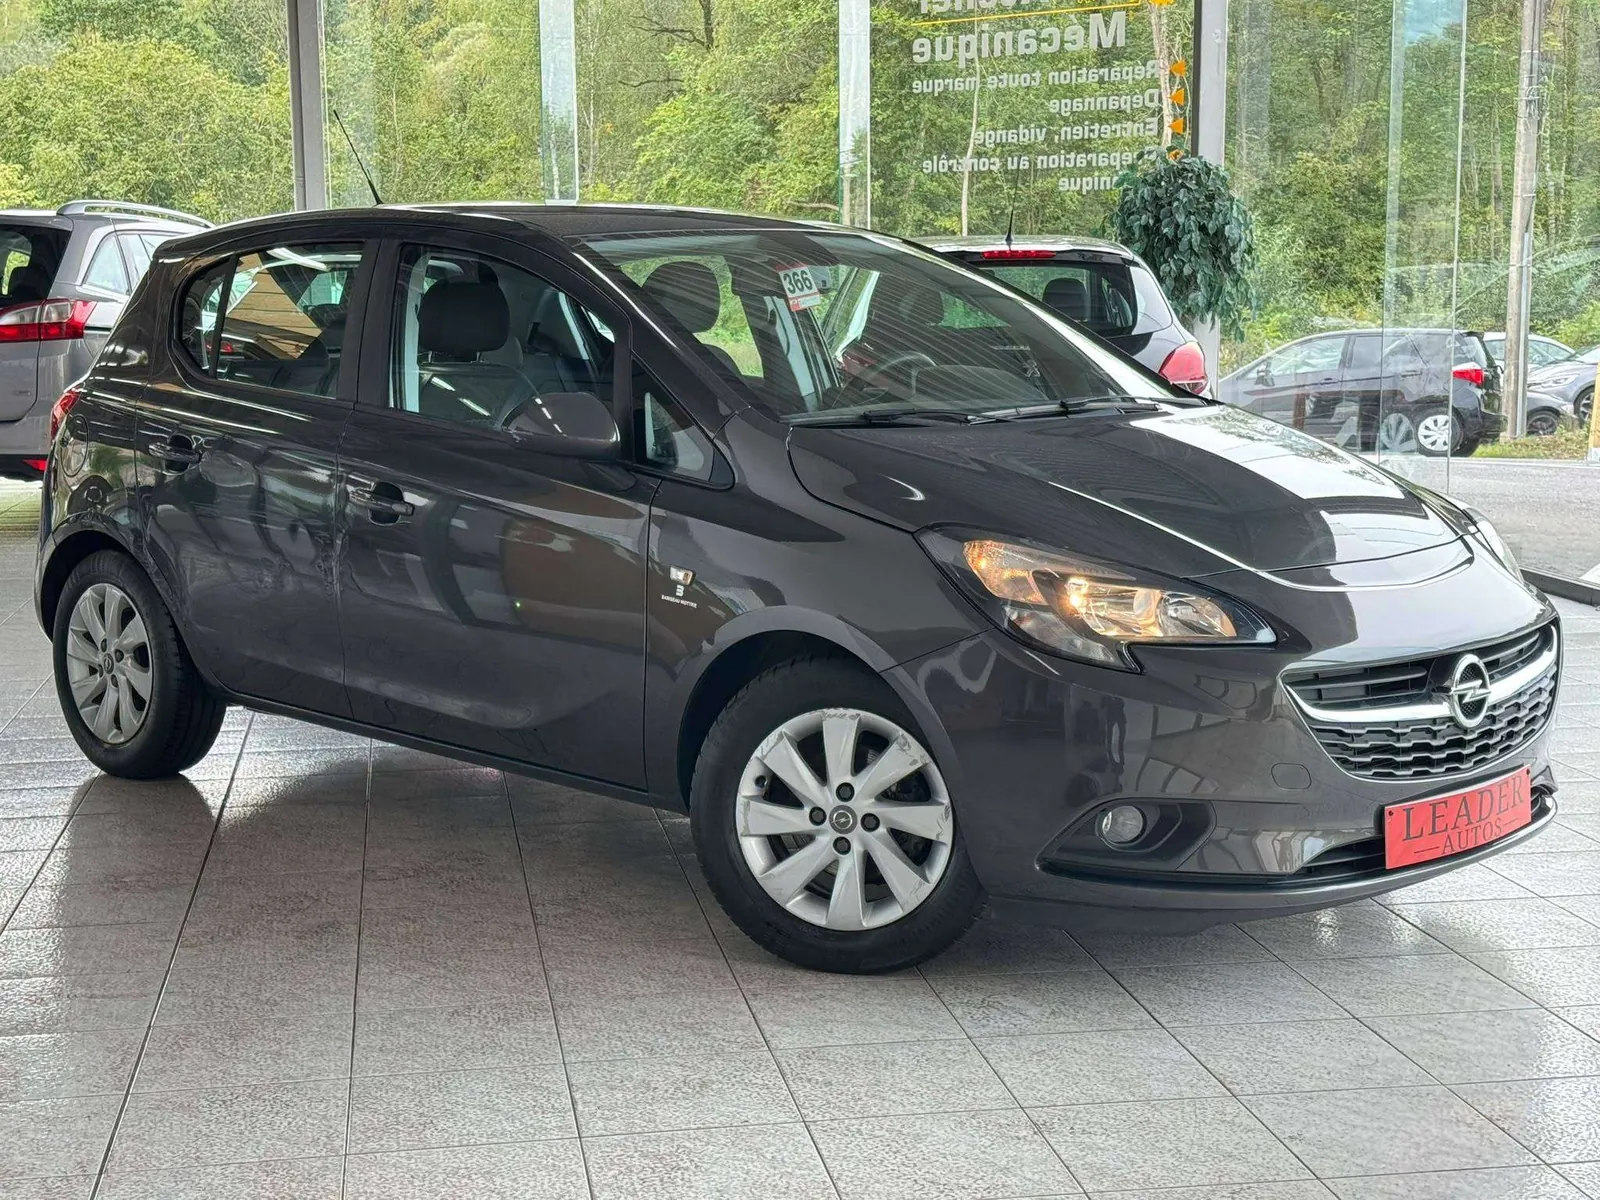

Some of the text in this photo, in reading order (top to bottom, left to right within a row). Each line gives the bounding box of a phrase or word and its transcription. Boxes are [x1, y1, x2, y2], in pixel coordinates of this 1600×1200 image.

[783, 270, 812, 294] 366
[1402, 776, 1525, 841] LEADER
[1441, 817, 1502, 855] AUTOS
